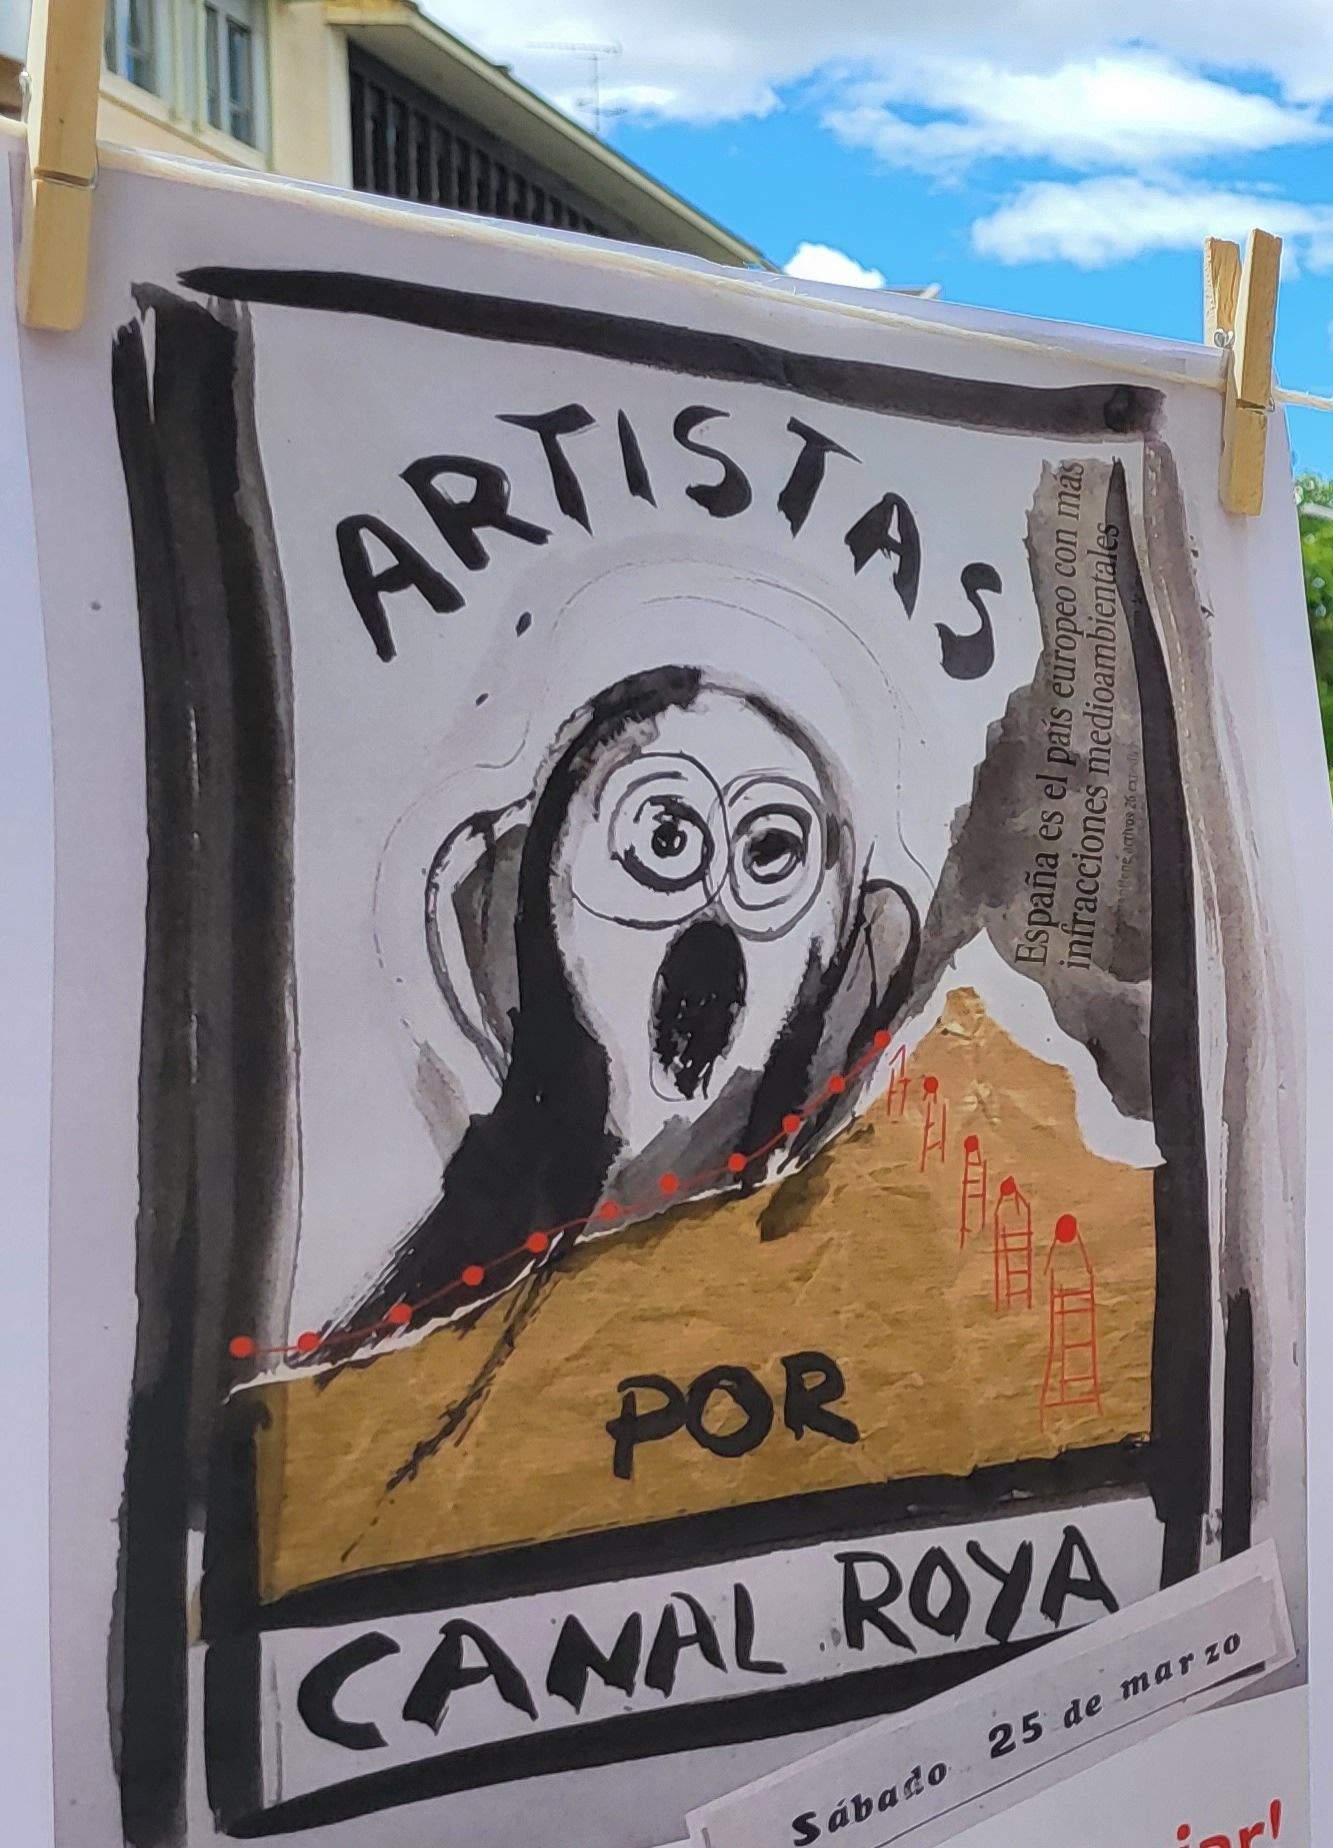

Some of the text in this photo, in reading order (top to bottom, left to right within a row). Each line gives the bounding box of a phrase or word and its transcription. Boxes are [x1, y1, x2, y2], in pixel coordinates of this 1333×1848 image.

[336, 402, 1003, 681] ARTISTAS
[1014, 461, 1084, 967] España es el país europeo con más
[1057, 522, 1119, 970] infracciones medioambientales
[606, 1351, 859, 1478] POR
[297, 1524, 1121, 1749] CANAL ROYA
[791, 1630, 1242, 1847] Sábado 25 de marzo
